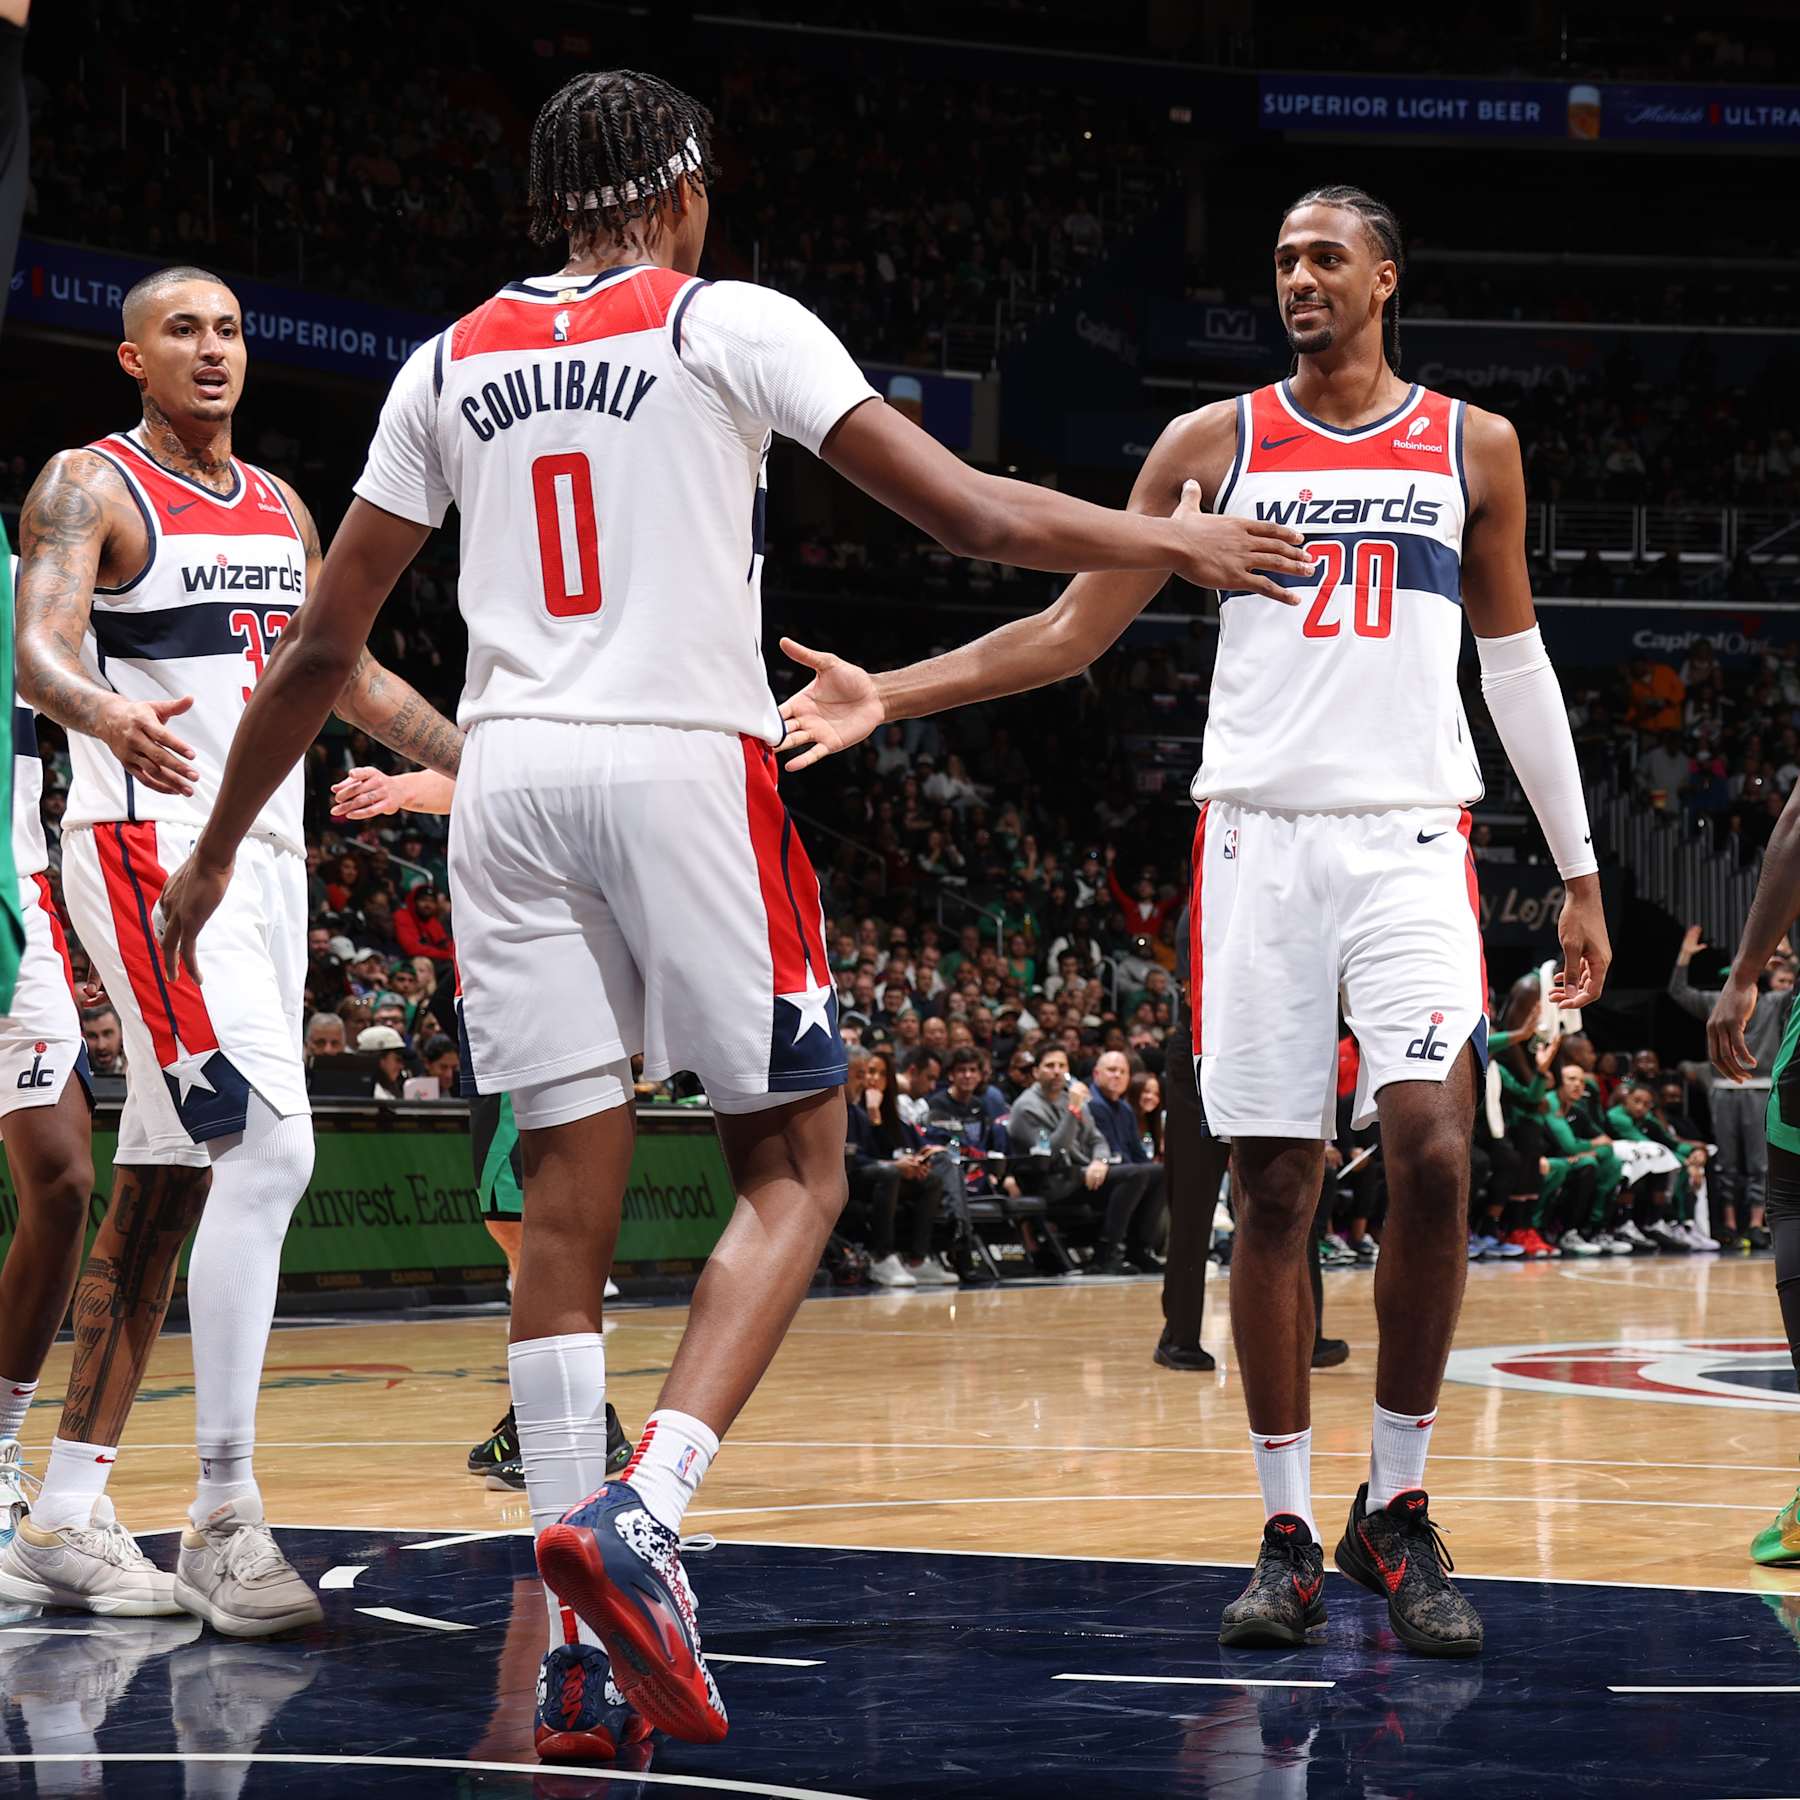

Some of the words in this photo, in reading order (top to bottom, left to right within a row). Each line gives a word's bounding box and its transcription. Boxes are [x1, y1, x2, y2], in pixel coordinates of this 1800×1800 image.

[1264, 93, 1388, 117] SUPERIOR
[1396, 98, 1470, 120] LIGHT
[1476, 100, 1541, 122] BEER
[245, 310, 377, 357] SUPERIOR
[461, 359, 658, 443] COULIBALY
[1392, 439, 1443, 454] Robinhood
[1255, 483, 1444, 527] wizards
[531, 451, 602, 618] 0
[181, 553, 302, 593] wizards
[1302, 541, 1397, 638] 20
